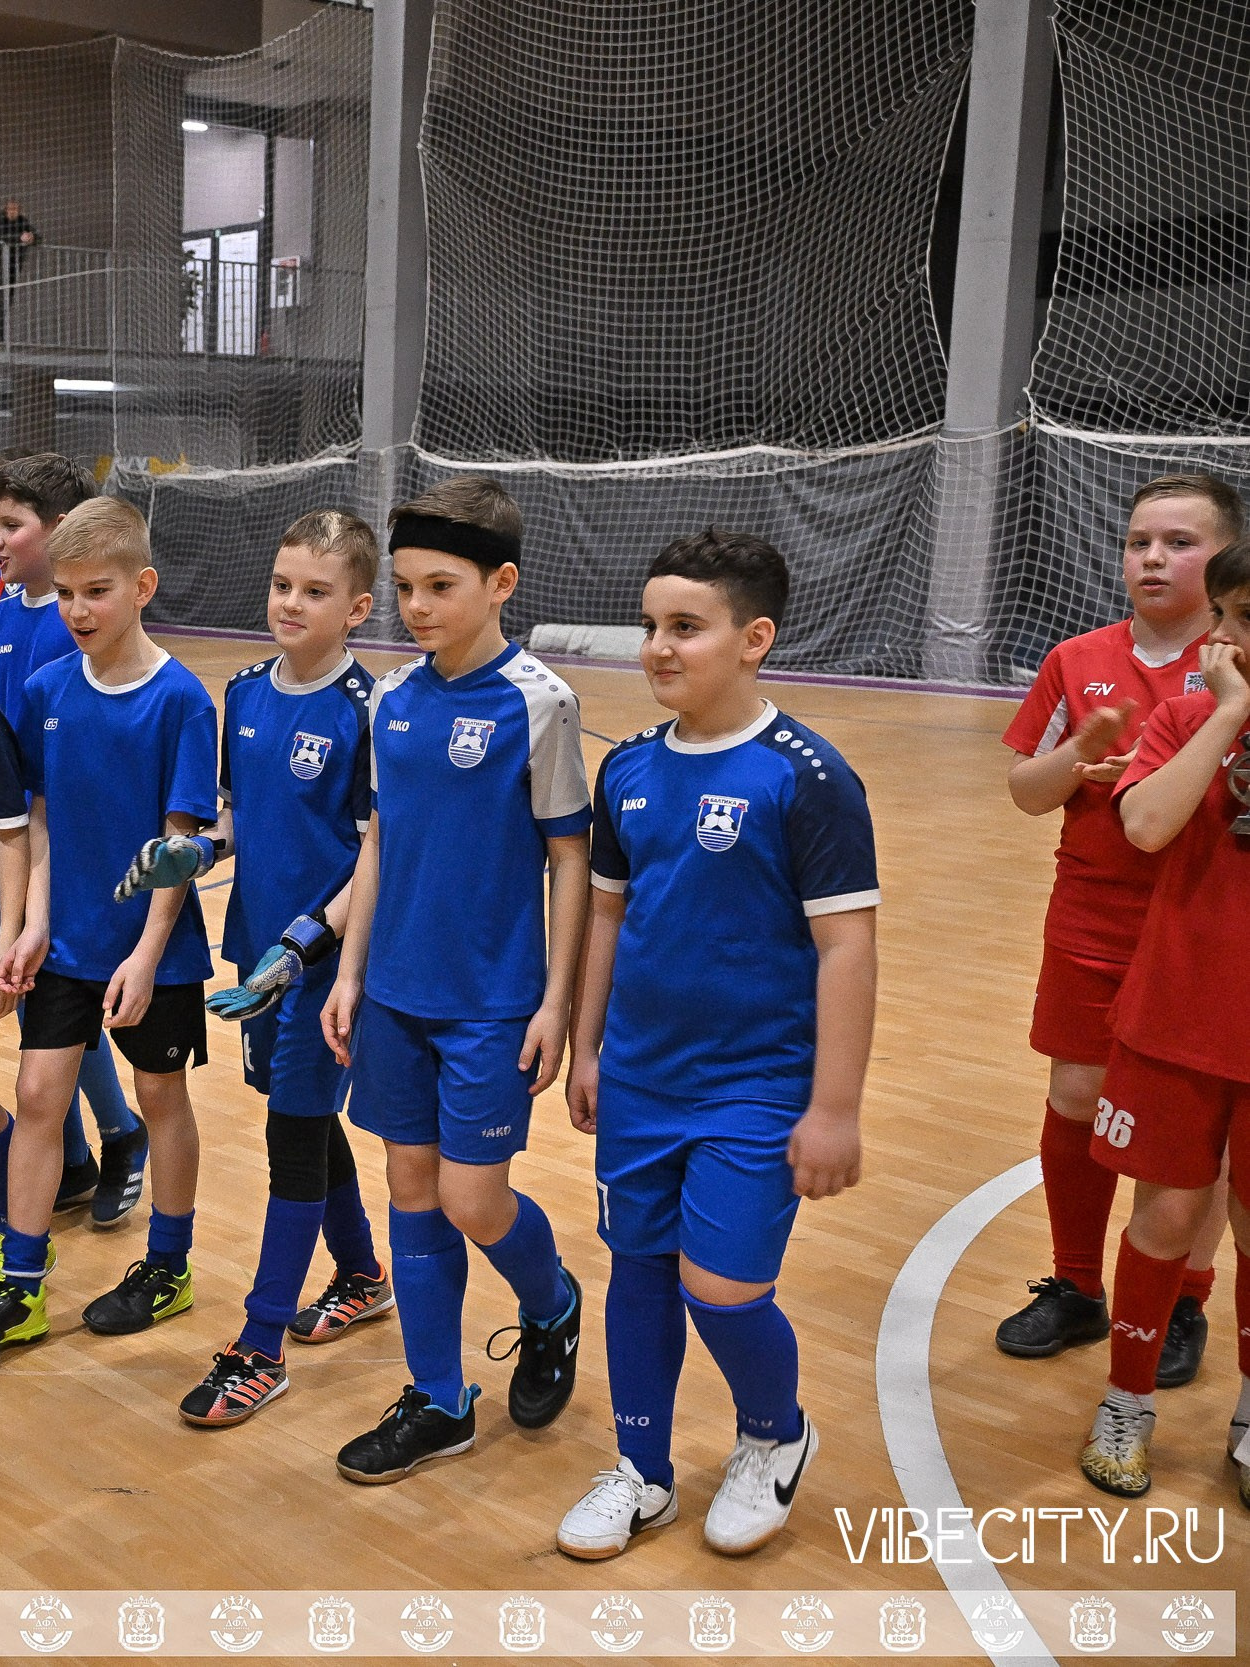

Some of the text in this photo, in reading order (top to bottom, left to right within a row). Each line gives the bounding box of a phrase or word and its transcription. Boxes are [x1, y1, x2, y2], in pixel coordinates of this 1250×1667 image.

[387, 719, 410, 732] JAKO
[621, 797, 647, 811] JAKO
[710, 798, 737, 806] БАЛТИКА
[1094, 1096, 1135, 1149] 36
[615, 1412, 649, 1427] AKO
